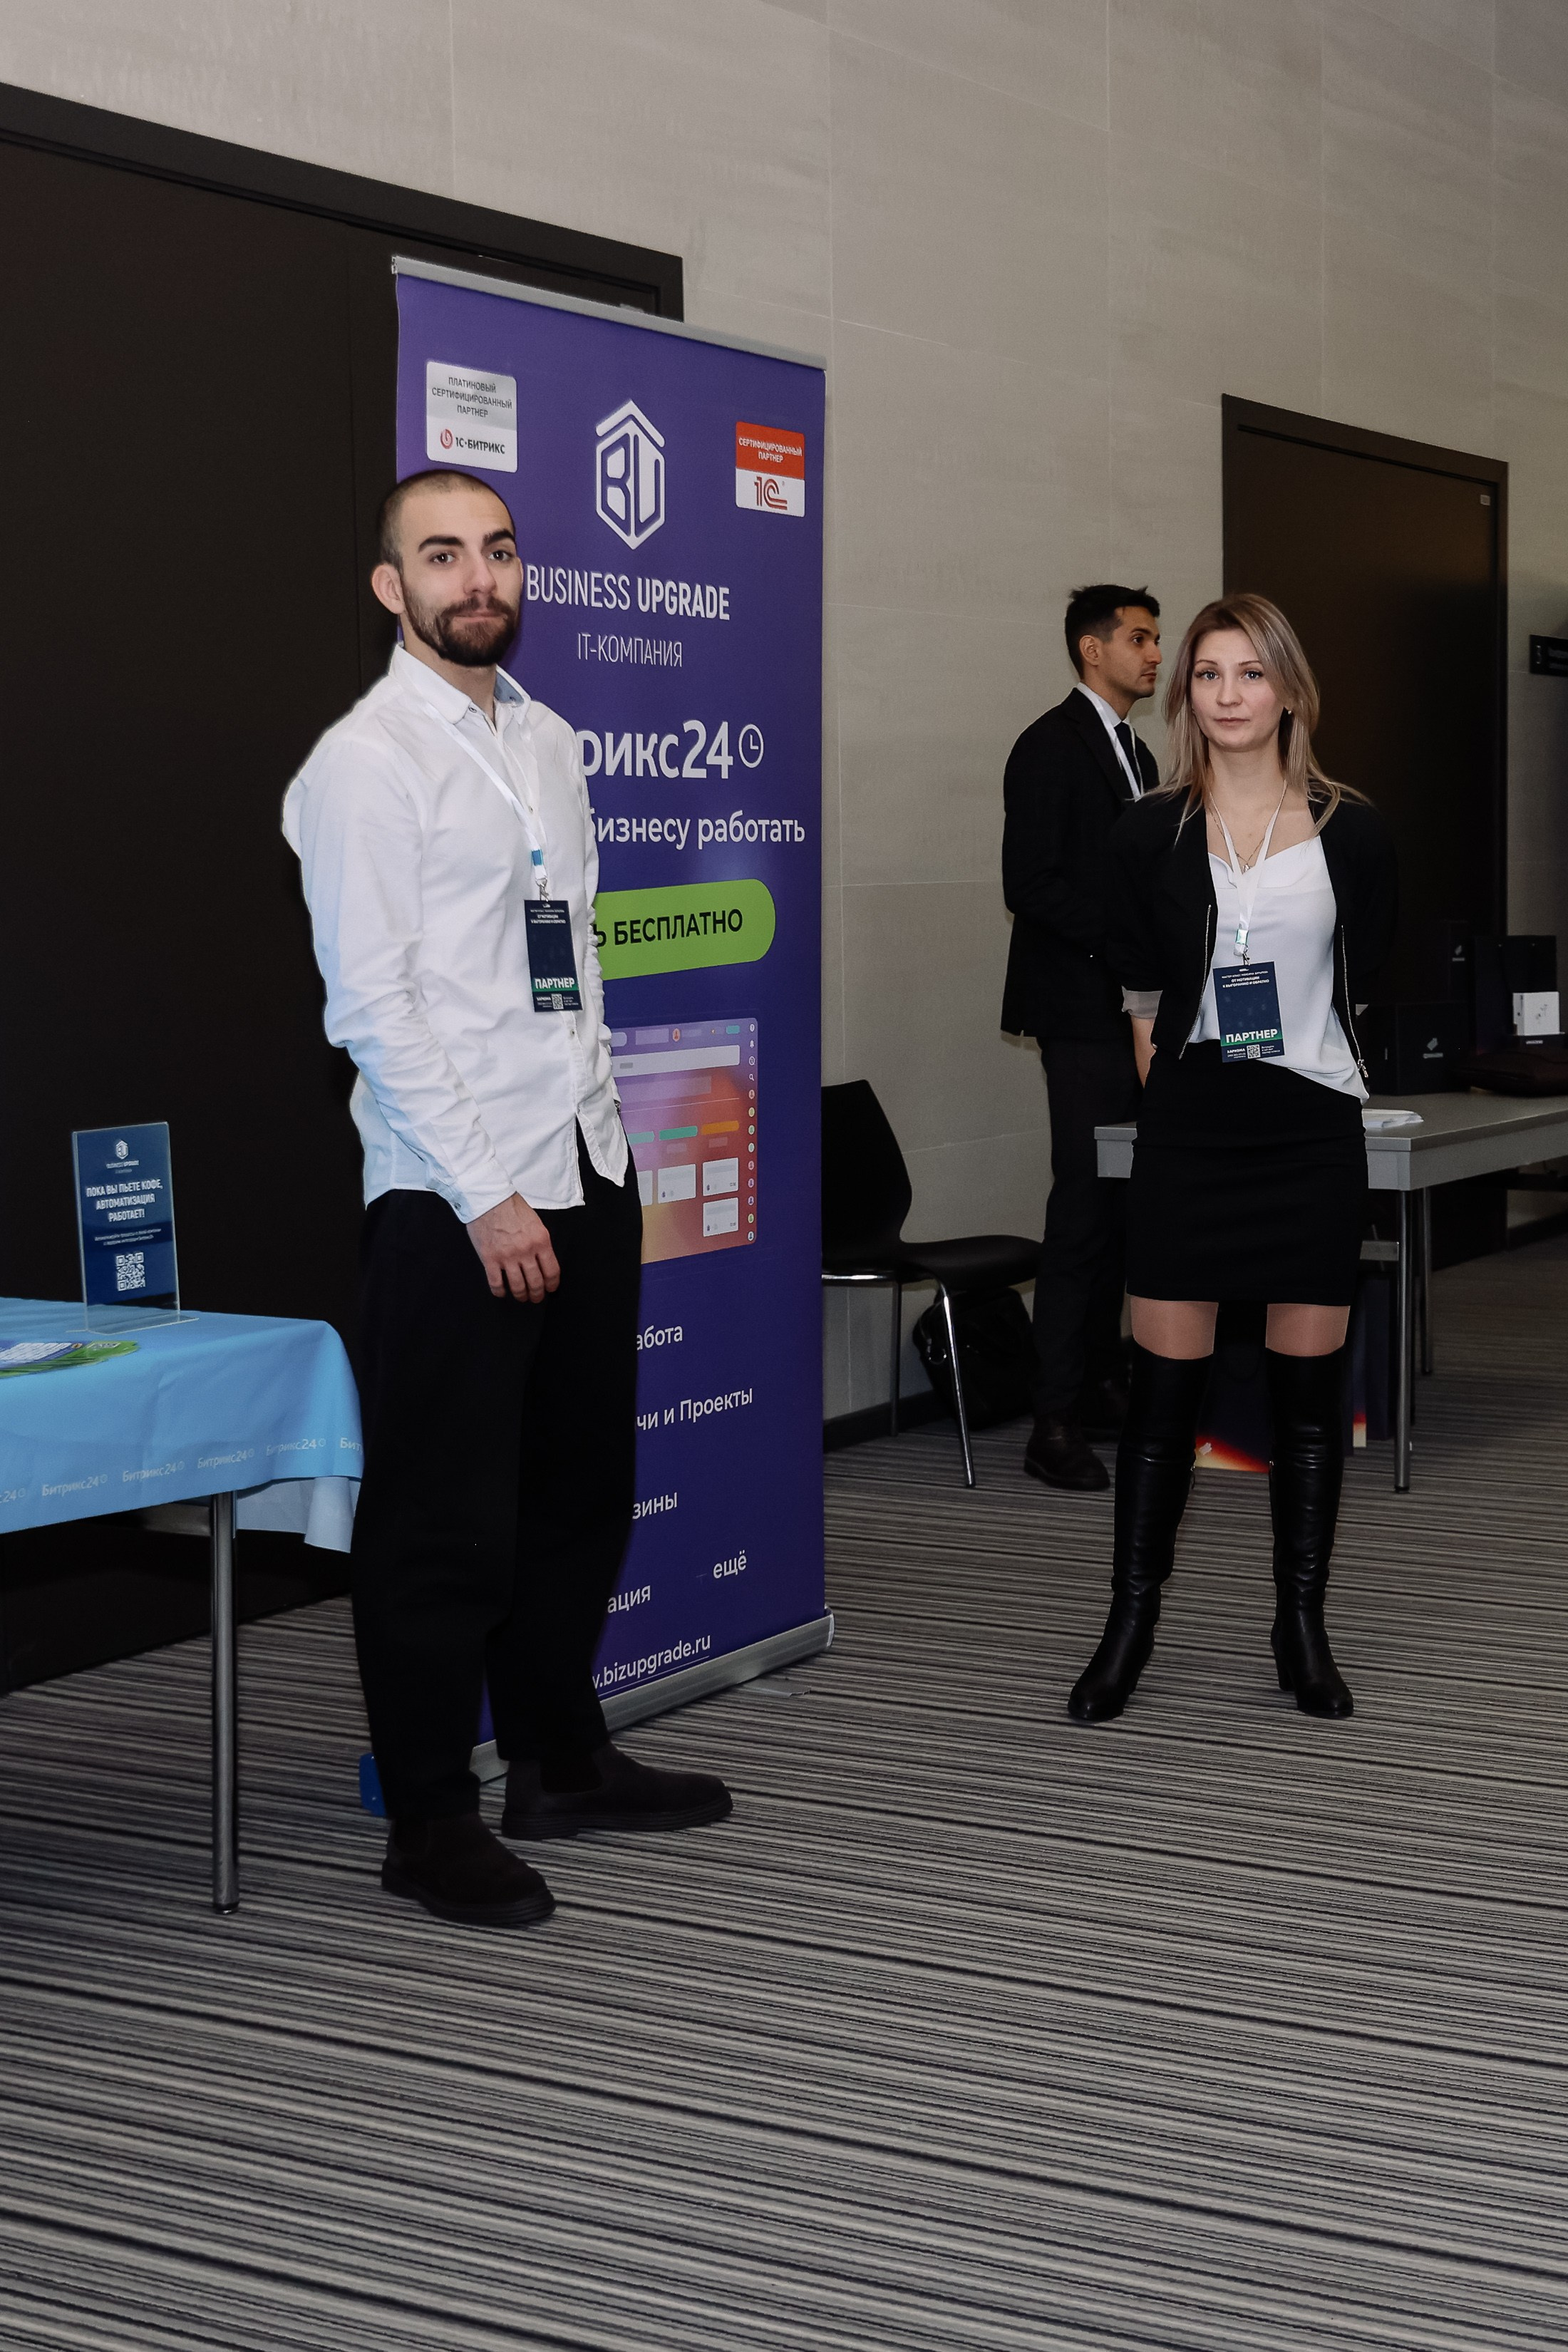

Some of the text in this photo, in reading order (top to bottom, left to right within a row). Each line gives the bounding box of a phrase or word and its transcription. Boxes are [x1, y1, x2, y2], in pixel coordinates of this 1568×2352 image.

[448, 377, 497, 393] ПЛАТИНОВЫЙ
[432, 387, 512, 409] СЕРТИФИЦИРОВАННЫЙ
[457, 405, 488, 418] ПАРТНЕР
[738, 438, 803, 456] СЕРТИФИЦИРОВАННЫЙ
[758, 451, 783, 463] ПАРТНЕР
[527, 564, 731, 621] BUSINESS UPGRADE
[577, 633, 683, 668] IT-КОМПАНИЯ
[590, 808, 805, 850] изнесу работать
[614, 908, 743, 946] БЕСПЛАТНО
[535, 977, 575, 989] ПАРТНЕР
[1226, 1028, 1278, 1043] ПАРТНЕР
[86, 1186, 105, 1197] ПОКА
[106, 1185, 118, 1195] ВЫ
[118, 1182, 140, 1193] ПЬЕТЕ
[96, 1193, 155, 1210] АВТОМАТИЗАЦИЯ
[108, 1209, 145, 1222] РАБОТАЕТ!
[664, 1408, 675, 1425] и
[679, 1388, 753, 1423] Проекты
[41, 1475, 99, 1497] Битрикс24
[632, 1492, 678, 1520] зины
[713, 1549, 748, 1579] ещё
[607, 1585, 651, 1614] ация
